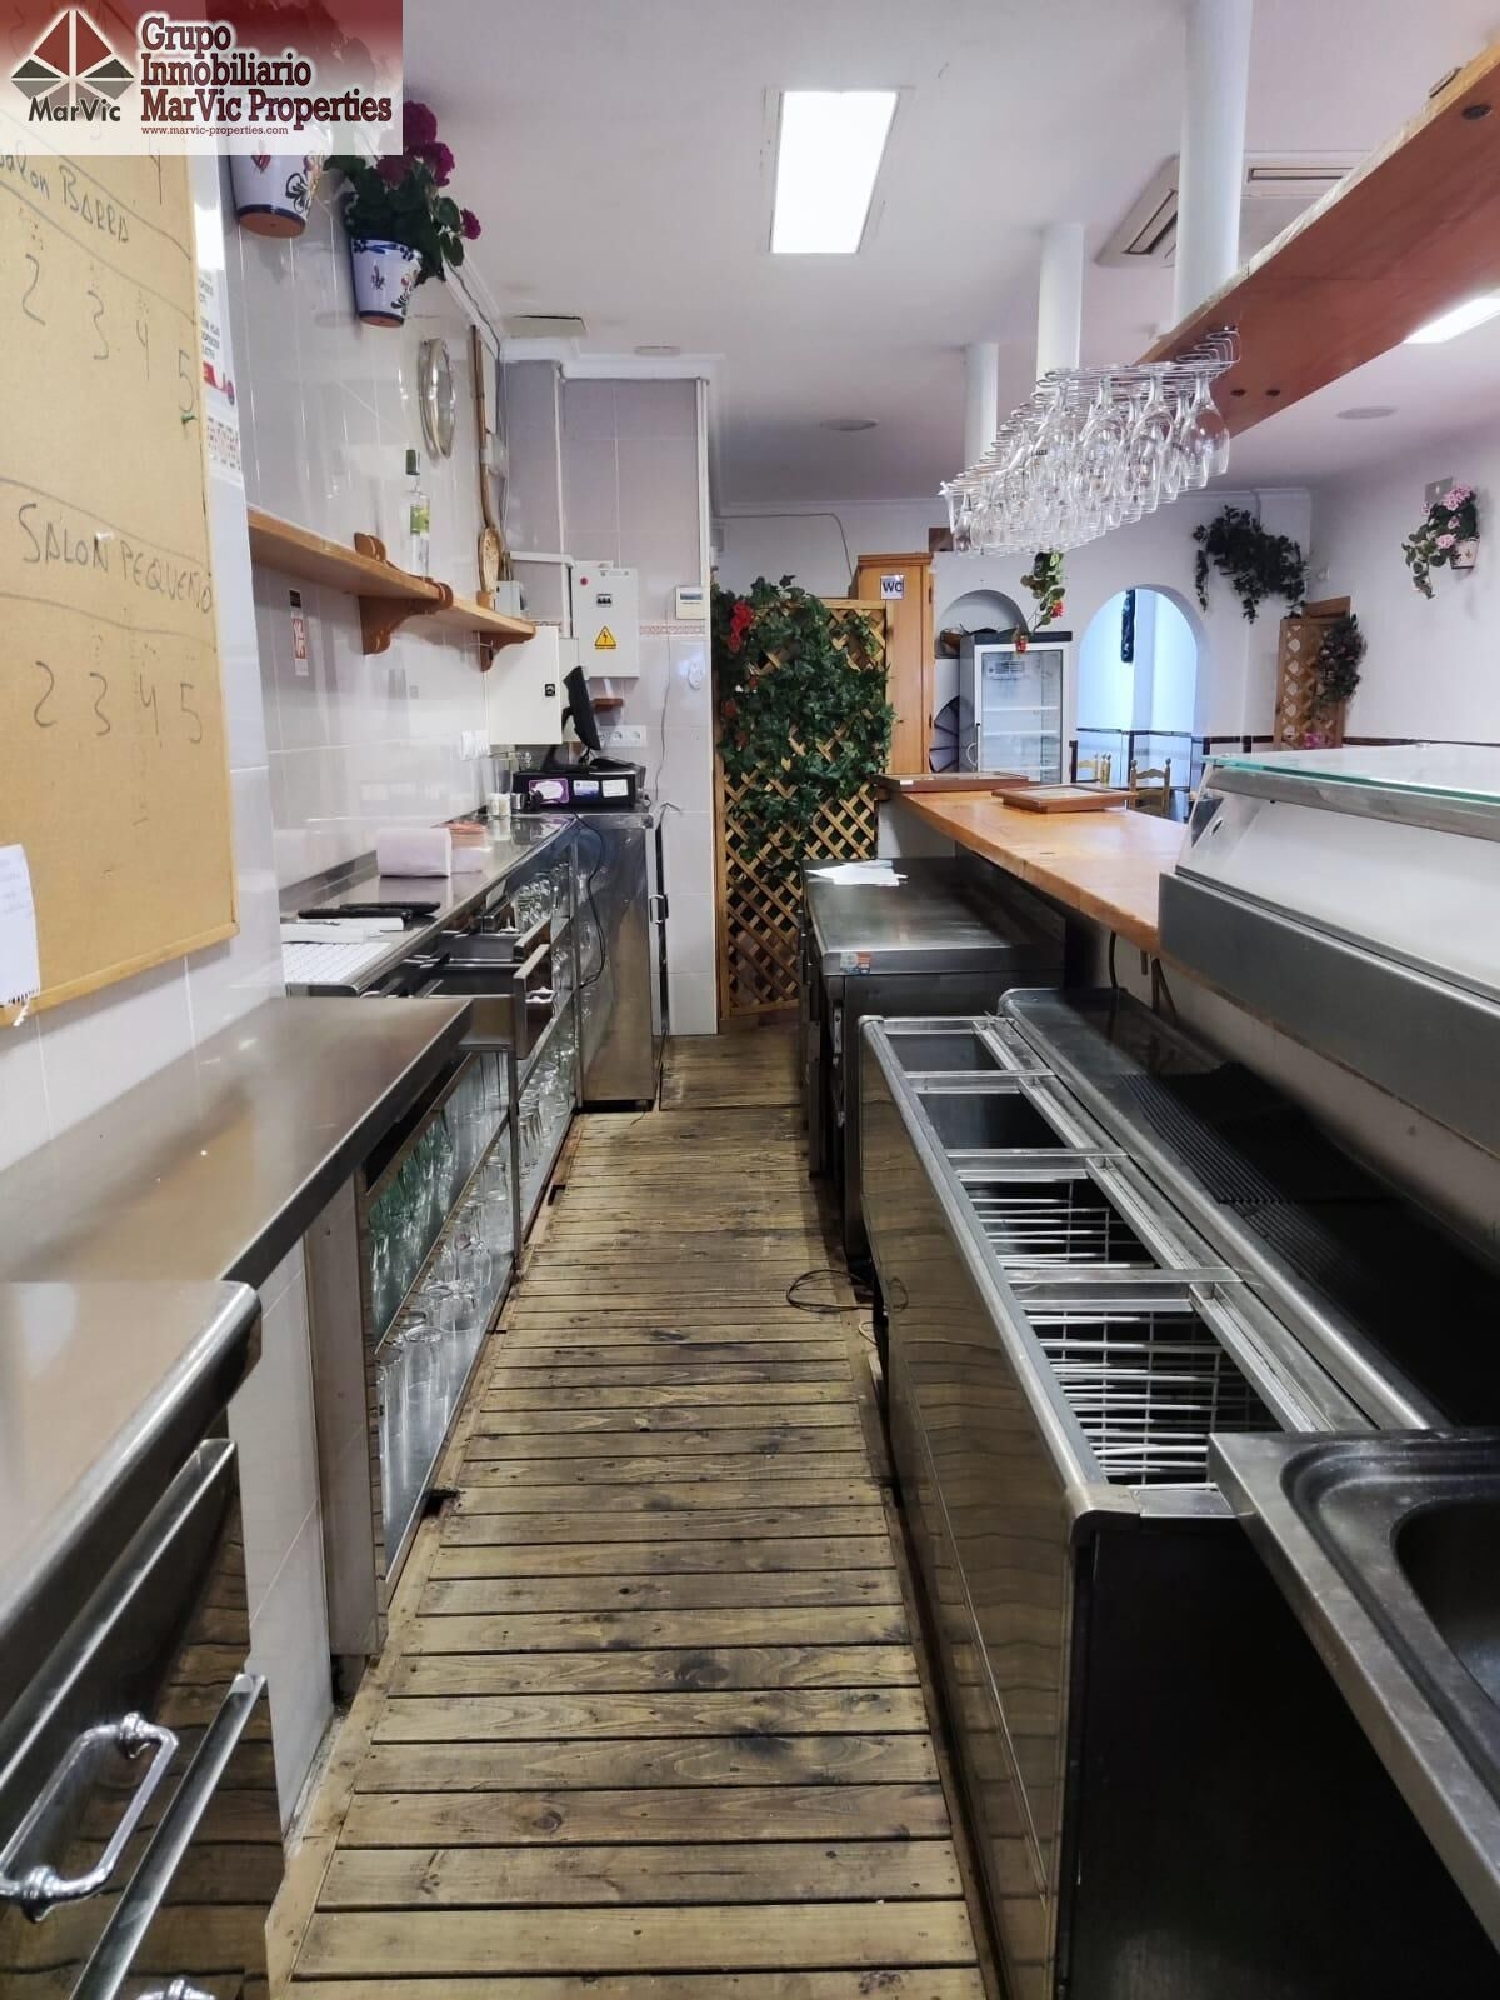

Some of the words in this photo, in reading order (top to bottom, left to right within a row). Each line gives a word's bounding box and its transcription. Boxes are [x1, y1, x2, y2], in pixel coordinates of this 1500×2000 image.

[18, 503, 110, 574] SALON
[883, 582, 902, 592] WC
[33, 660, 58, 728] 2
[89, 672, 111, 736] 3
[179, 682, 202, 744] 5
